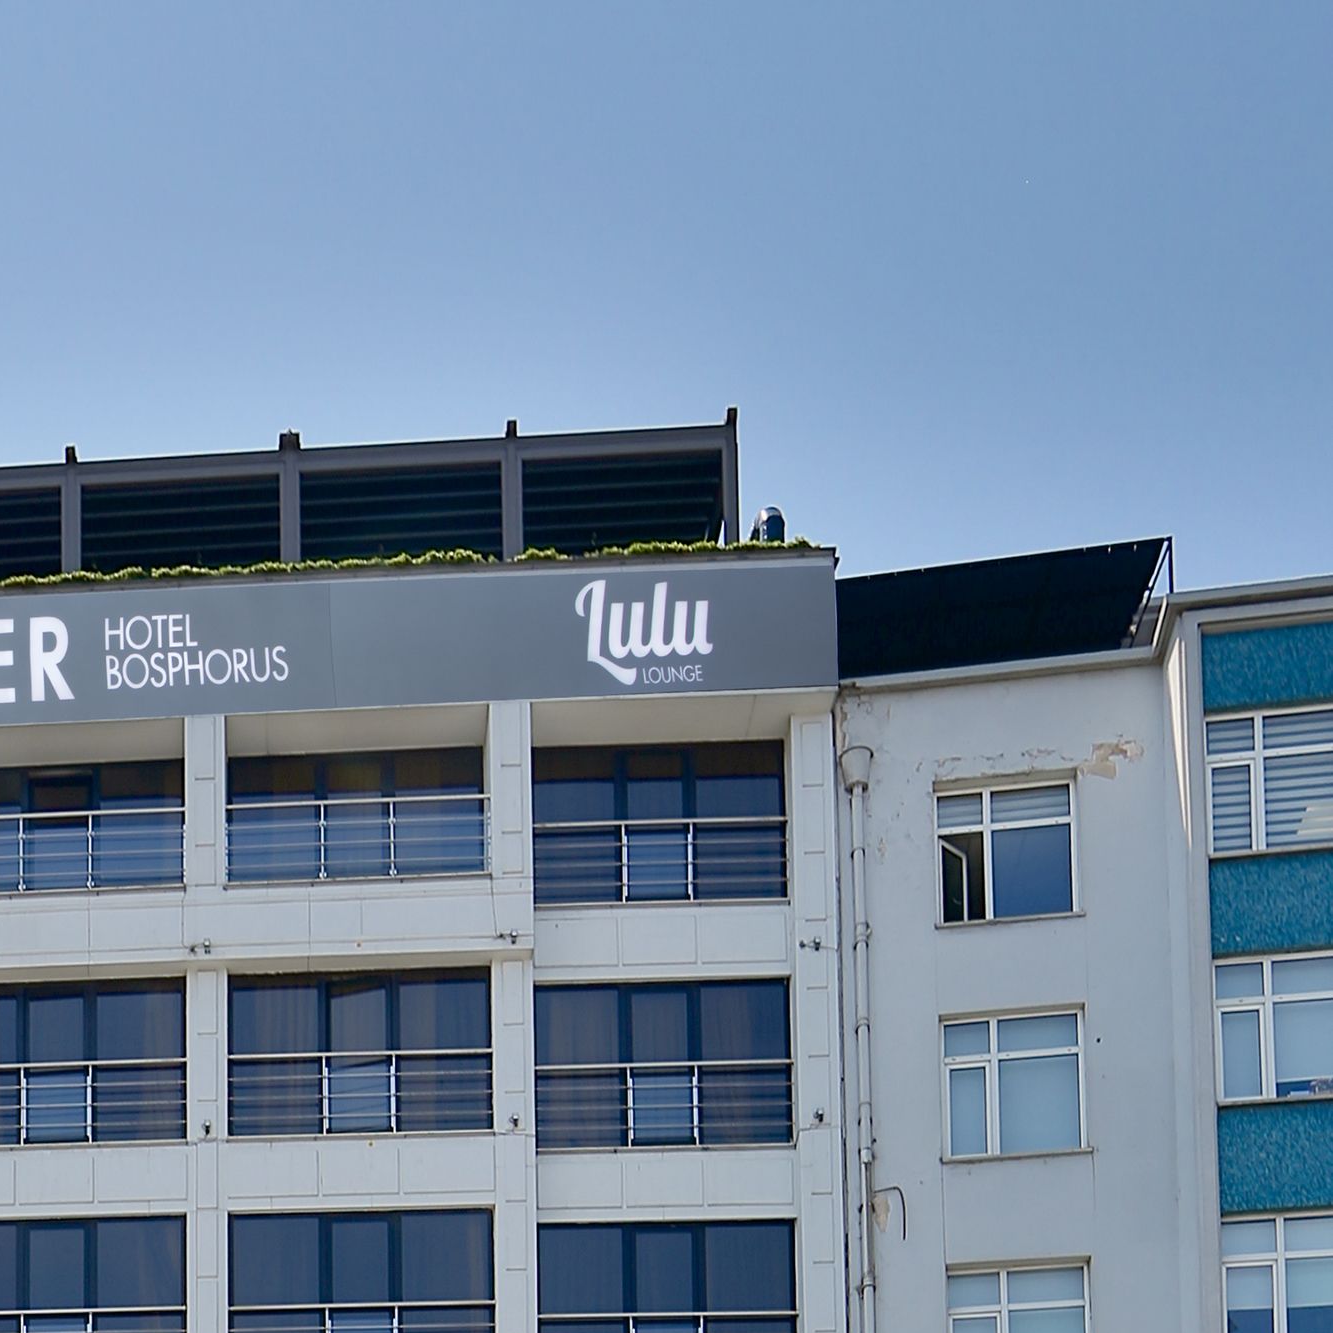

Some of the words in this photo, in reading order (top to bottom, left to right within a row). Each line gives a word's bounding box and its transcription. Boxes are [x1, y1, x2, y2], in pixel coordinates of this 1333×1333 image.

[104, 613, 198, 652] HOTEL
[574, 579, 713, 686] Lulu
[105, 645, 289, 690] BOSPHORUS
[642, 664, 704, 685] LOUNGE
